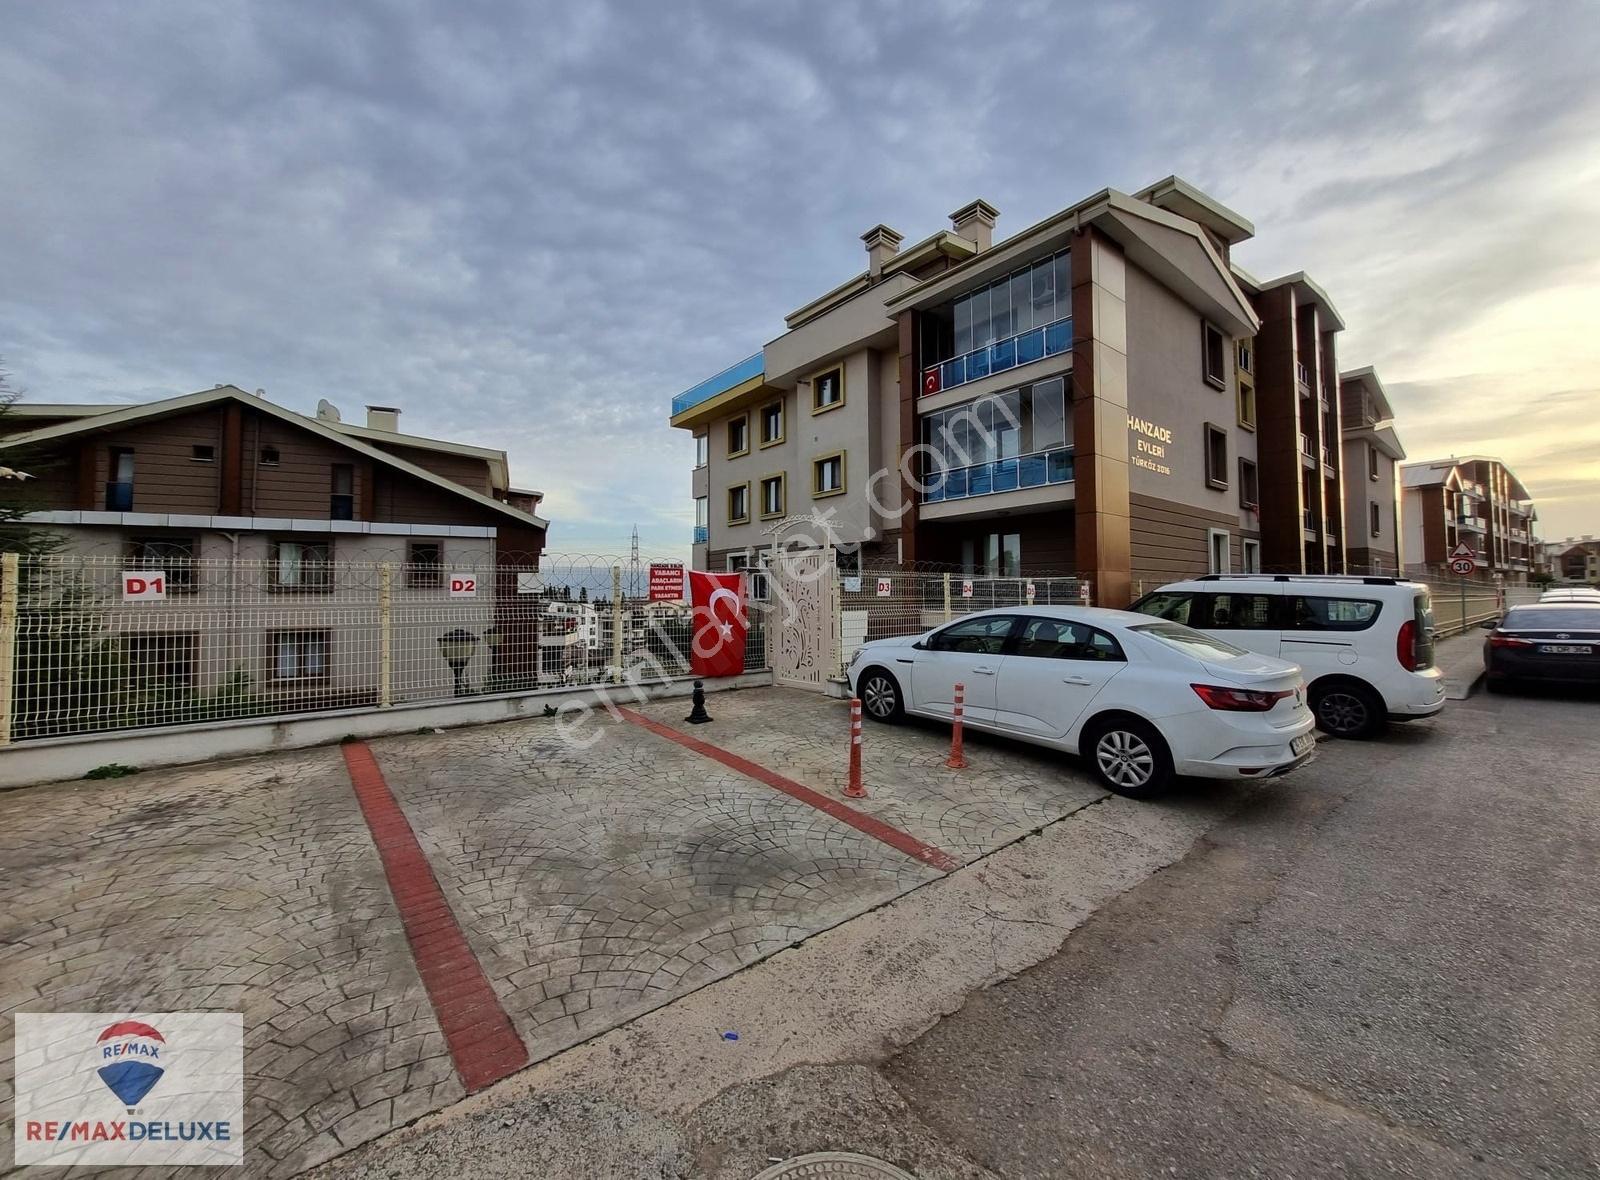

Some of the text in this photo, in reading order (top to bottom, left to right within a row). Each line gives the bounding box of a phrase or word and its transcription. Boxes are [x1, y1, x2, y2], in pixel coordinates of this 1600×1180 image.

[1126, 414, 1172, 444] HANZADE
[1137, 439, 1165, 458] EVLERİ
[1131, 455, 1157, 471] TÜRKÖZ
[1455, 562, 1470, 571] 30
[126, 578, 163, 594] D1
[451, 580, 475, 592] D2
[878, 582, 890, 591] D3
[963, 585, 972, 593] D4
